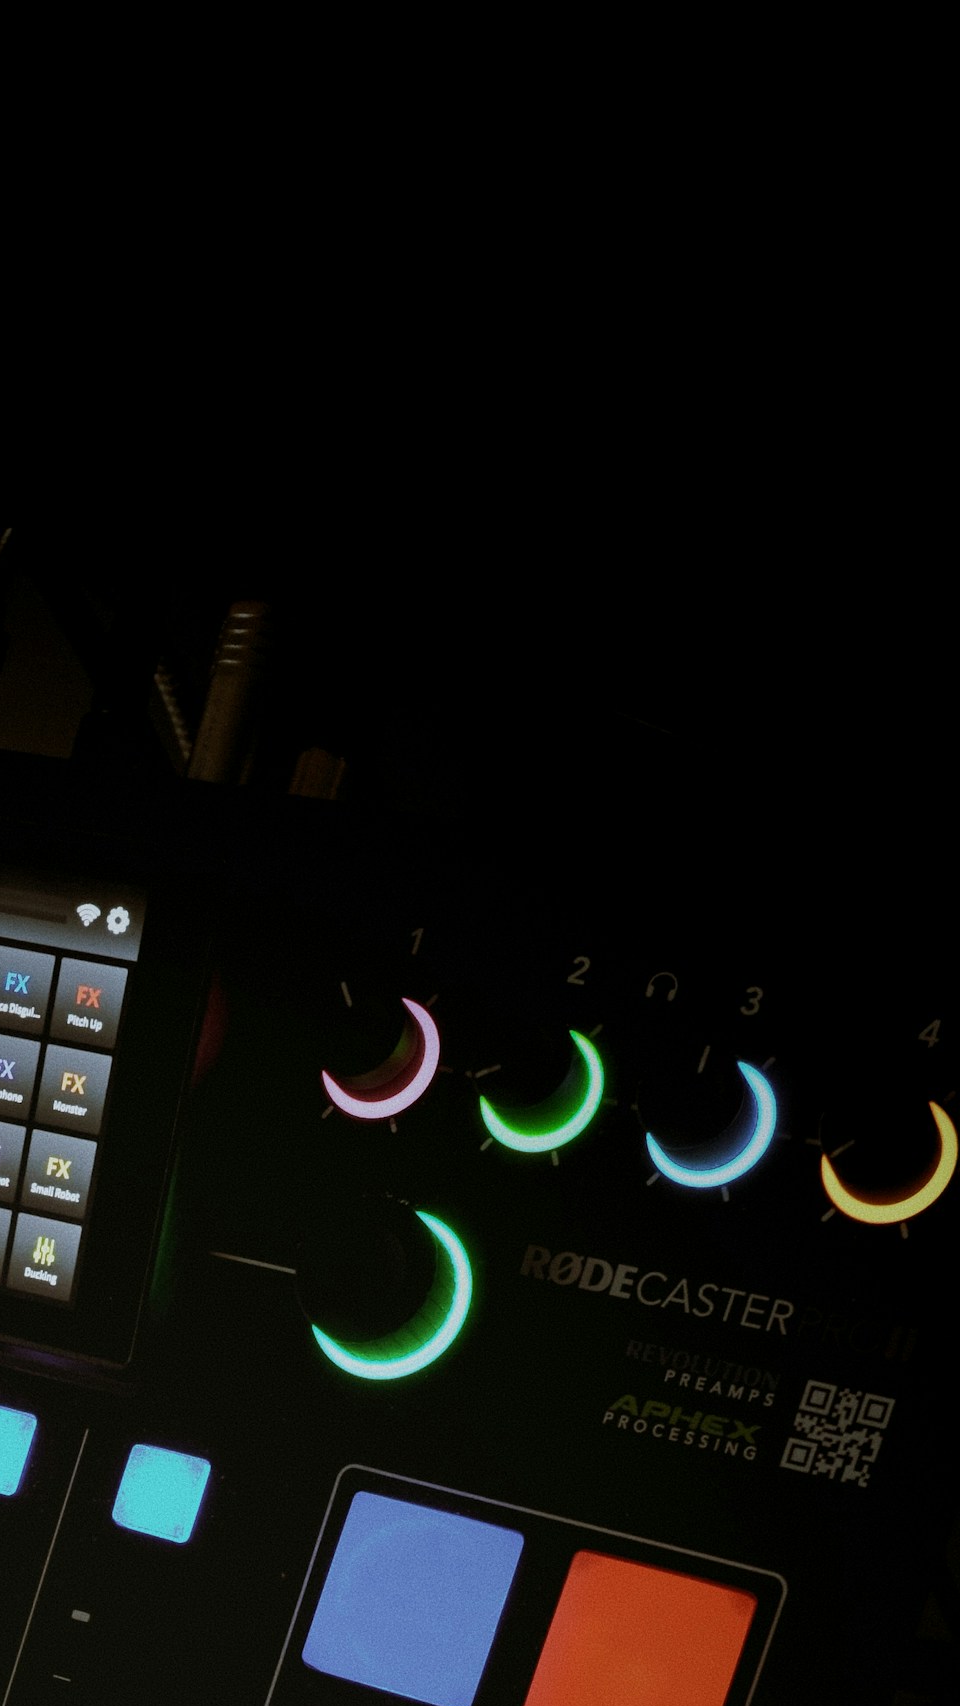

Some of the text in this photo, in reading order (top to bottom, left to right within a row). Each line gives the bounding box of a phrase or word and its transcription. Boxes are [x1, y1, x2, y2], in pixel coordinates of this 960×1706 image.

[410, 927, 425, 956] 1
[5, 972, 30, 994] FX
[567, 954, 592, 986] 2
[76, 985, 102, 1009] FX
[739, 985, 765, 1017] 3
[67, 1013, 103, 1033] Pitch Up
[919, 1018, 942, 1048] 4
[61, 1071, 87, 1095] FX
[52, 1100, 88, 1118] Monster
[46, 1156, 72, 1180] FX
[30, 1182, 81, 1203] Small Robot
[23, 1266, 58, 1286] Ducking
[520, 1243, 796, 1337] RØDECASTER
[625, 1339, 782, 1391] REVOLUTION
[663, 1369, 776, 1407] PREAMPS
[608, 1393, 762, 1444] APHEX
[601, 1411, 759, 1462] PROCESSING
